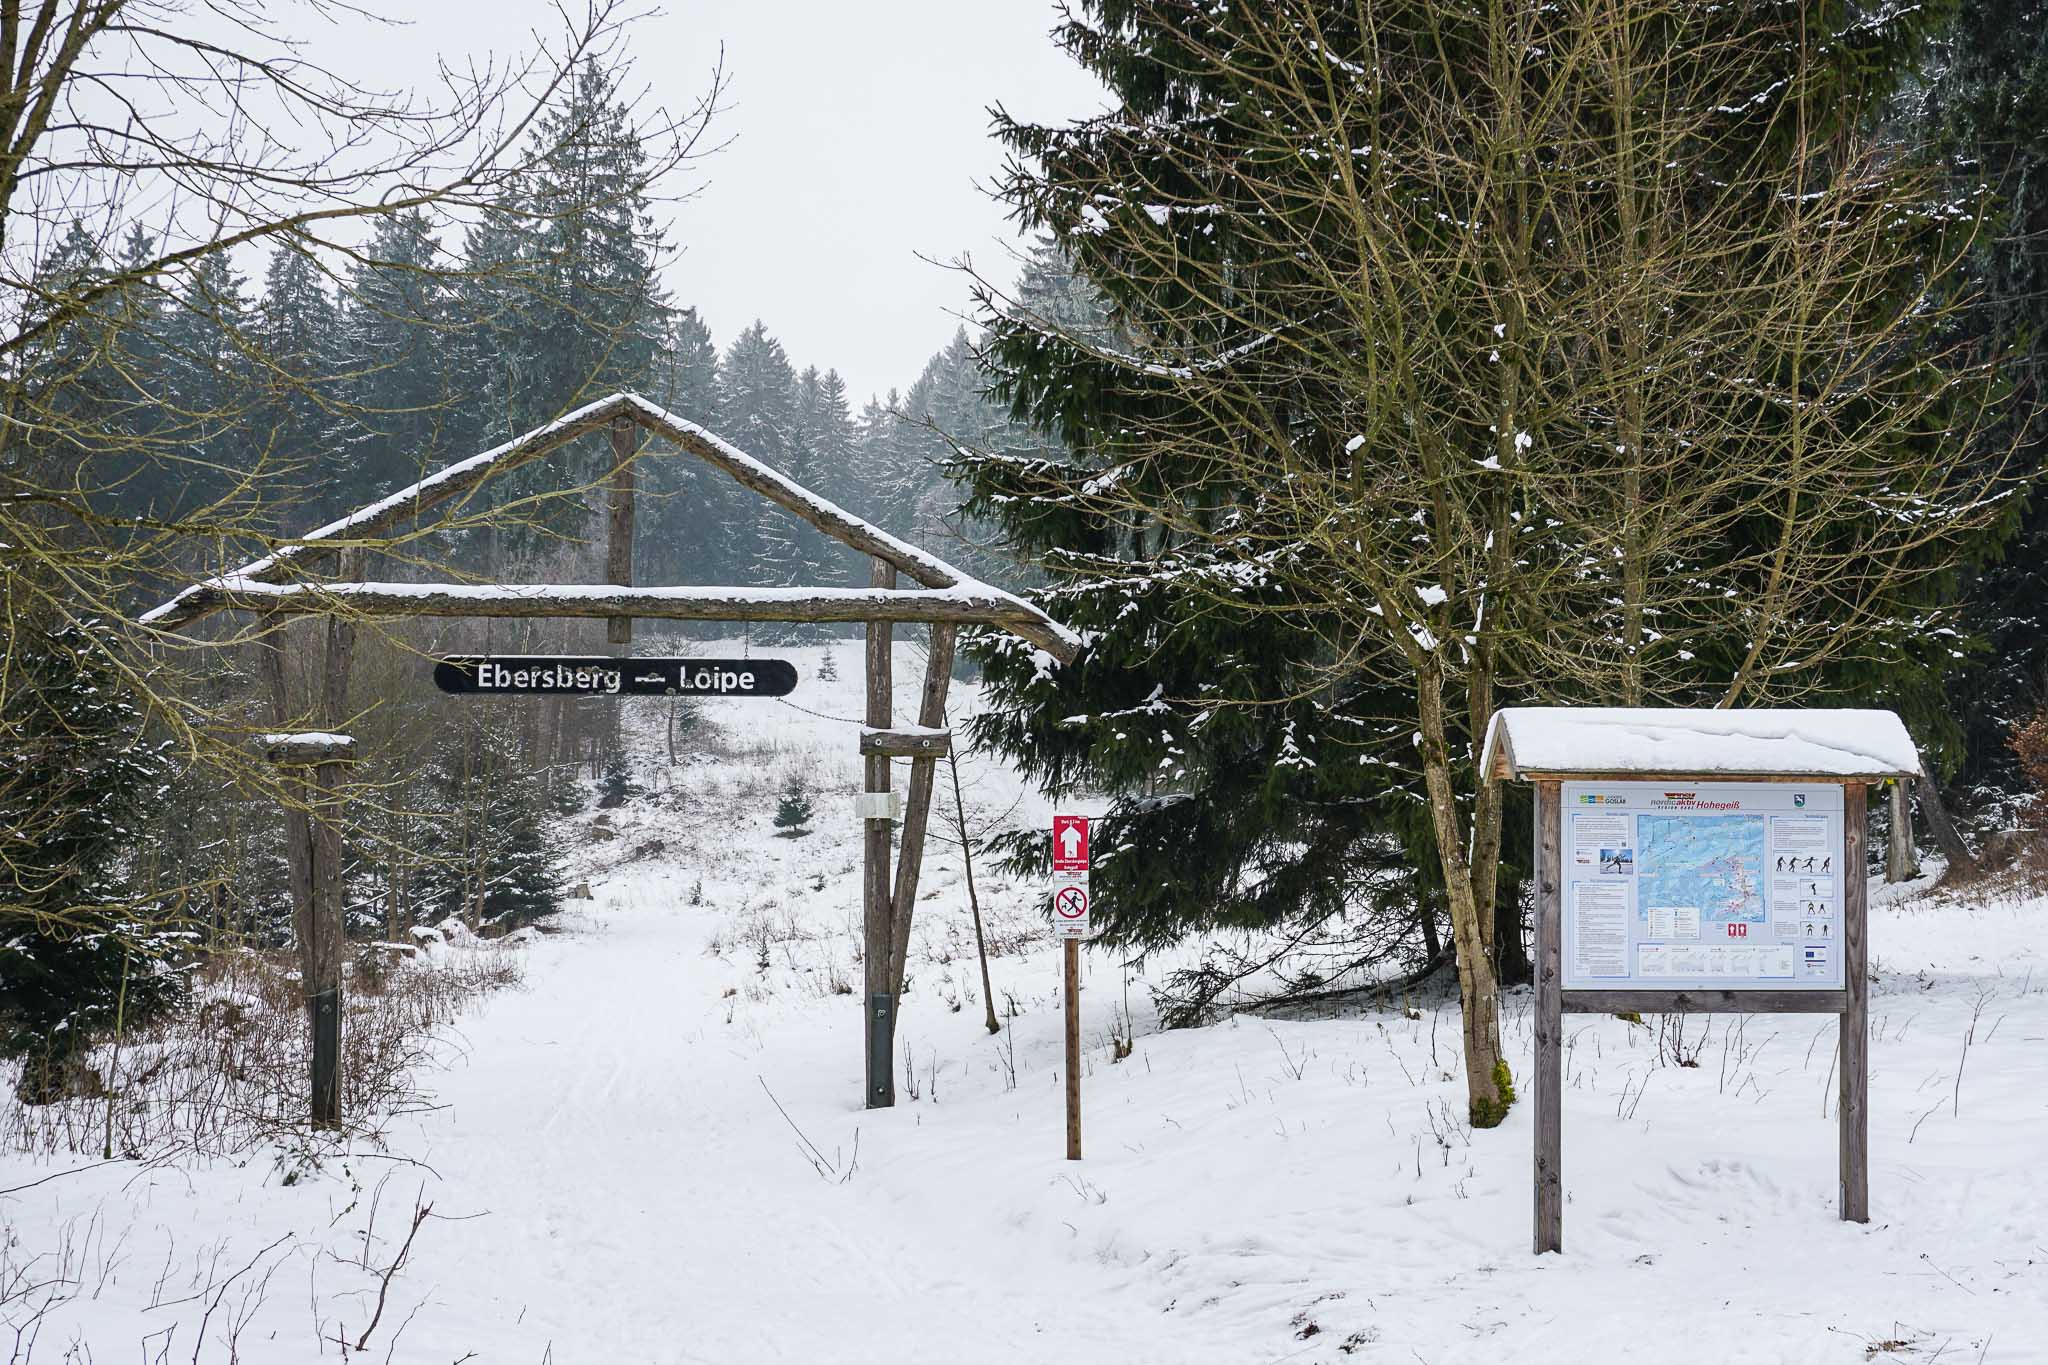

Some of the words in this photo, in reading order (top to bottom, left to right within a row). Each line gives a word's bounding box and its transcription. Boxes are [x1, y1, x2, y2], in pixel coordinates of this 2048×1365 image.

[478, 663, 621, 694] Ebersberg
[680, 666, 755, 693] Loipe
[1696, 800, 1740, 810] Hohegeiß
